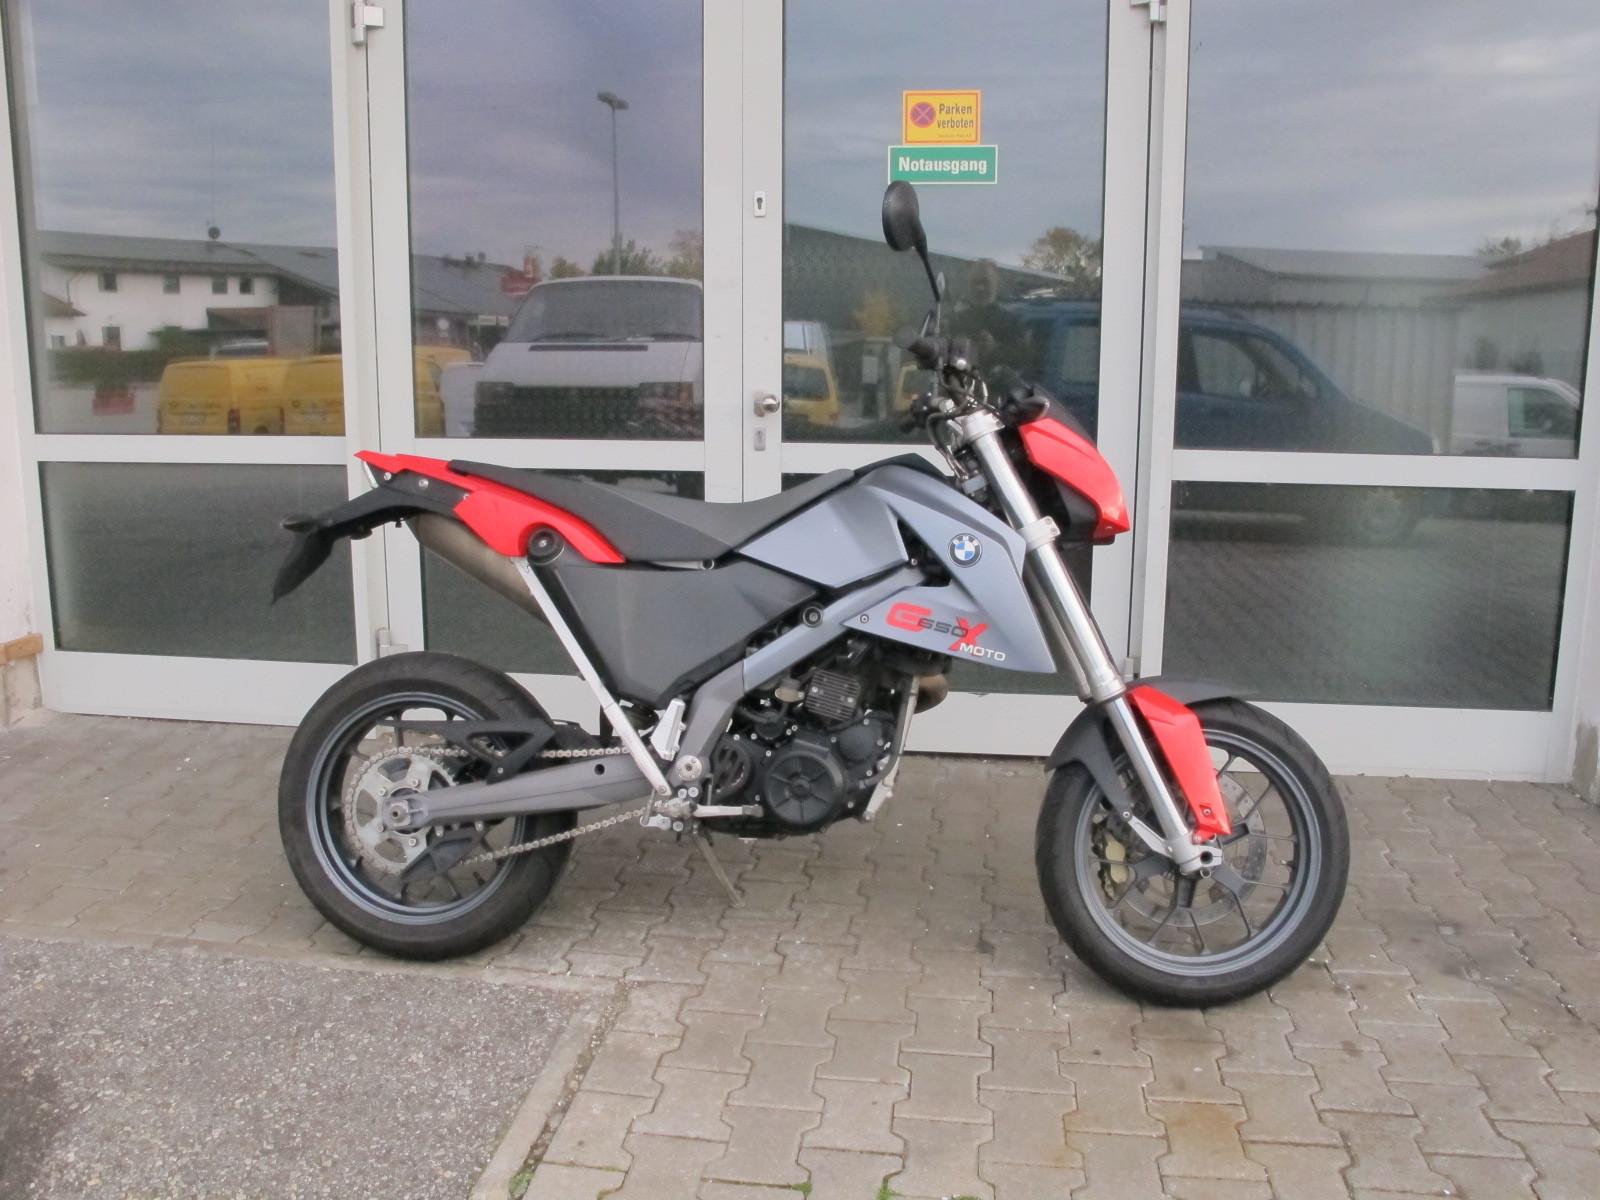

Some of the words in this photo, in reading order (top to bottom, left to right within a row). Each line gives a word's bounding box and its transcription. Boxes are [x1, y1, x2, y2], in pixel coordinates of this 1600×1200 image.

[938, 103, 972, 115] Parken
[937, 118, 974, 129] verboten
[898, 156, 987, 175] Notausgang
[952, 535, 979, 547] BMW
[959, 642, 1006, 662] MOTO
